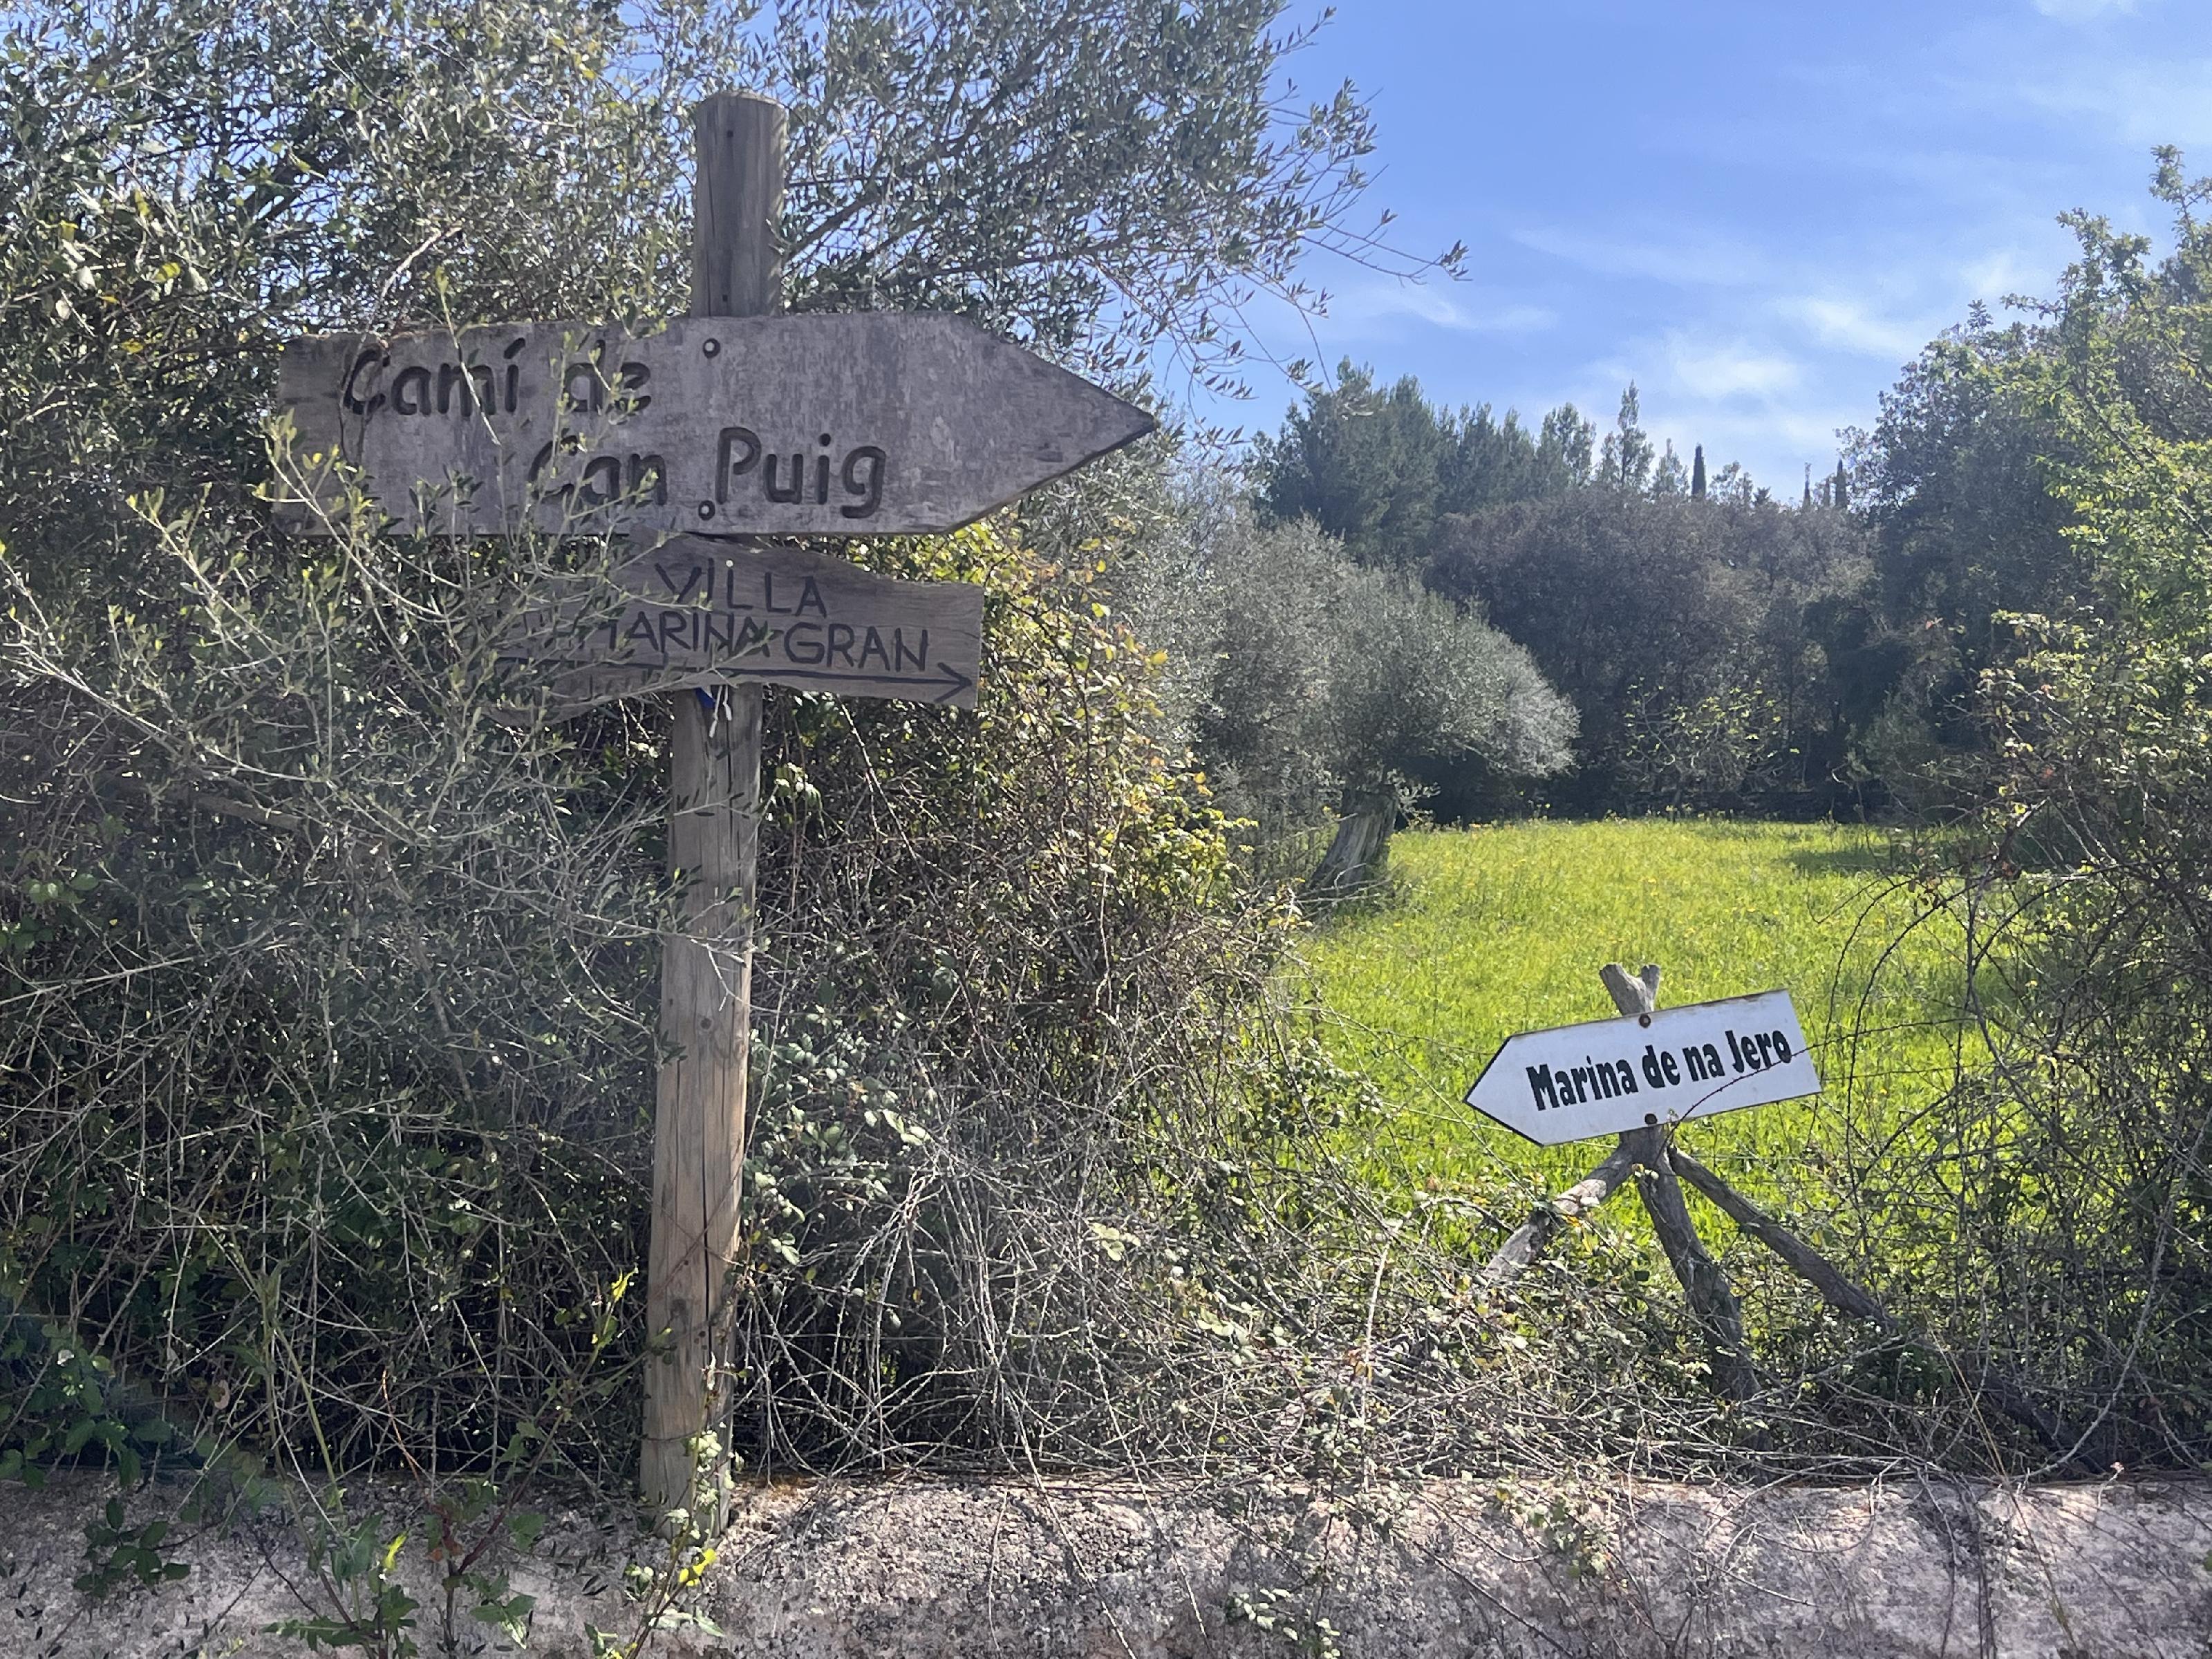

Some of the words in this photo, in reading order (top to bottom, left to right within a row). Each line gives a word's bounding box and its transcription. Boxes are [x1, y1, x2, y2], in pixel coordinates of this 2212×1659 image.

[343, 337, 527, 417] Camí
[563, 339, 652, 413] de
[527, 434, 668, 507] Can
[715, 427, 887, 518] Puig
[654, 557, 827, 617] VILLA
[783, 621, 928, 672] GRAN
[1526, 1055, 1638, 1110] Marina
[1642, 1044, 1683, 1089] de
[1683, 1043, 1725, 1082] na
[1725, 1029, 1792, 1074] Jero
